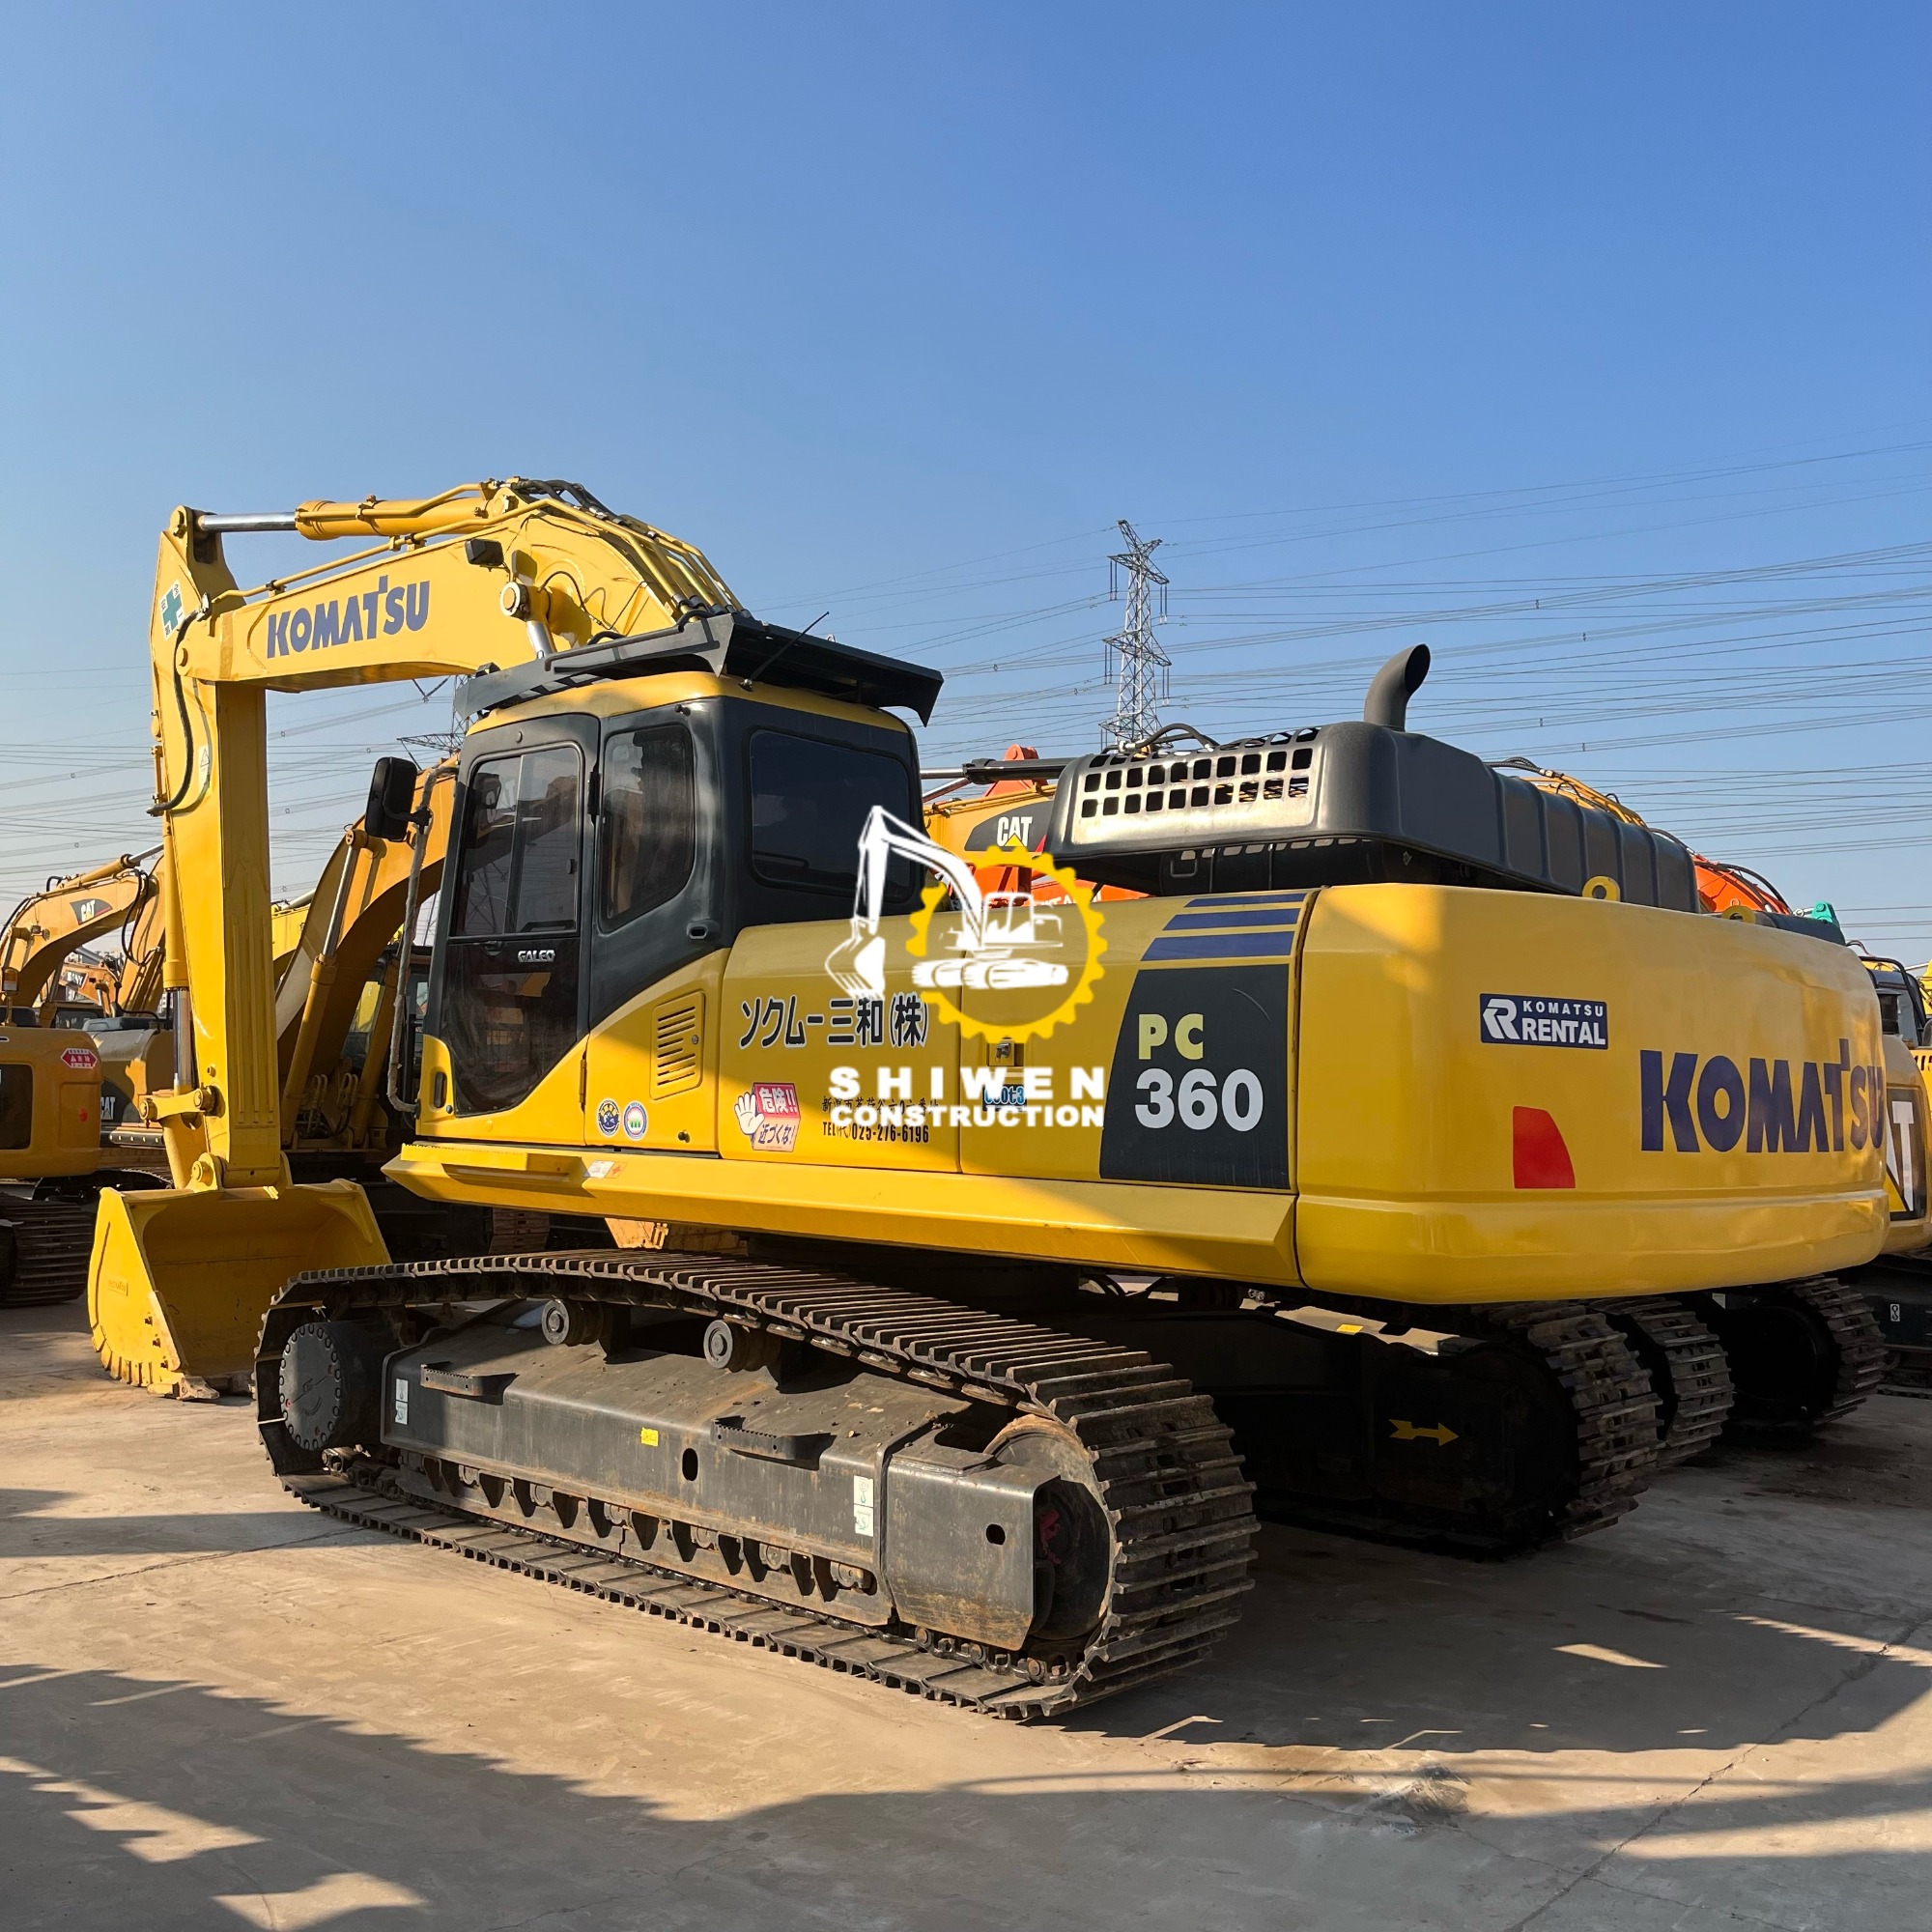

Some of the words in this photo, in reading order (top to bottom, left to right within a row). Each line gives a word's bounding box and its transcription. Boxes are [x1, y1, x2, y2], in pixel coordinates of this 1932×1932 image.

[267, 575, 430, 659] KOMATSU
[997, 816, 1033, 846] CAT
[81, 899, 95, 922] CAT
[518, 950, 555, 963] GALEO
[1522, 1001, 1604, 1017] KOMATSU
[1138, 1013, 1204, 1061] PC
[1521, 1017, 1606, 1045] RENTAL
[1134, 1067, 1264, 1132] 360
[1640, 1038, 1883, 1153] KOMATSU
